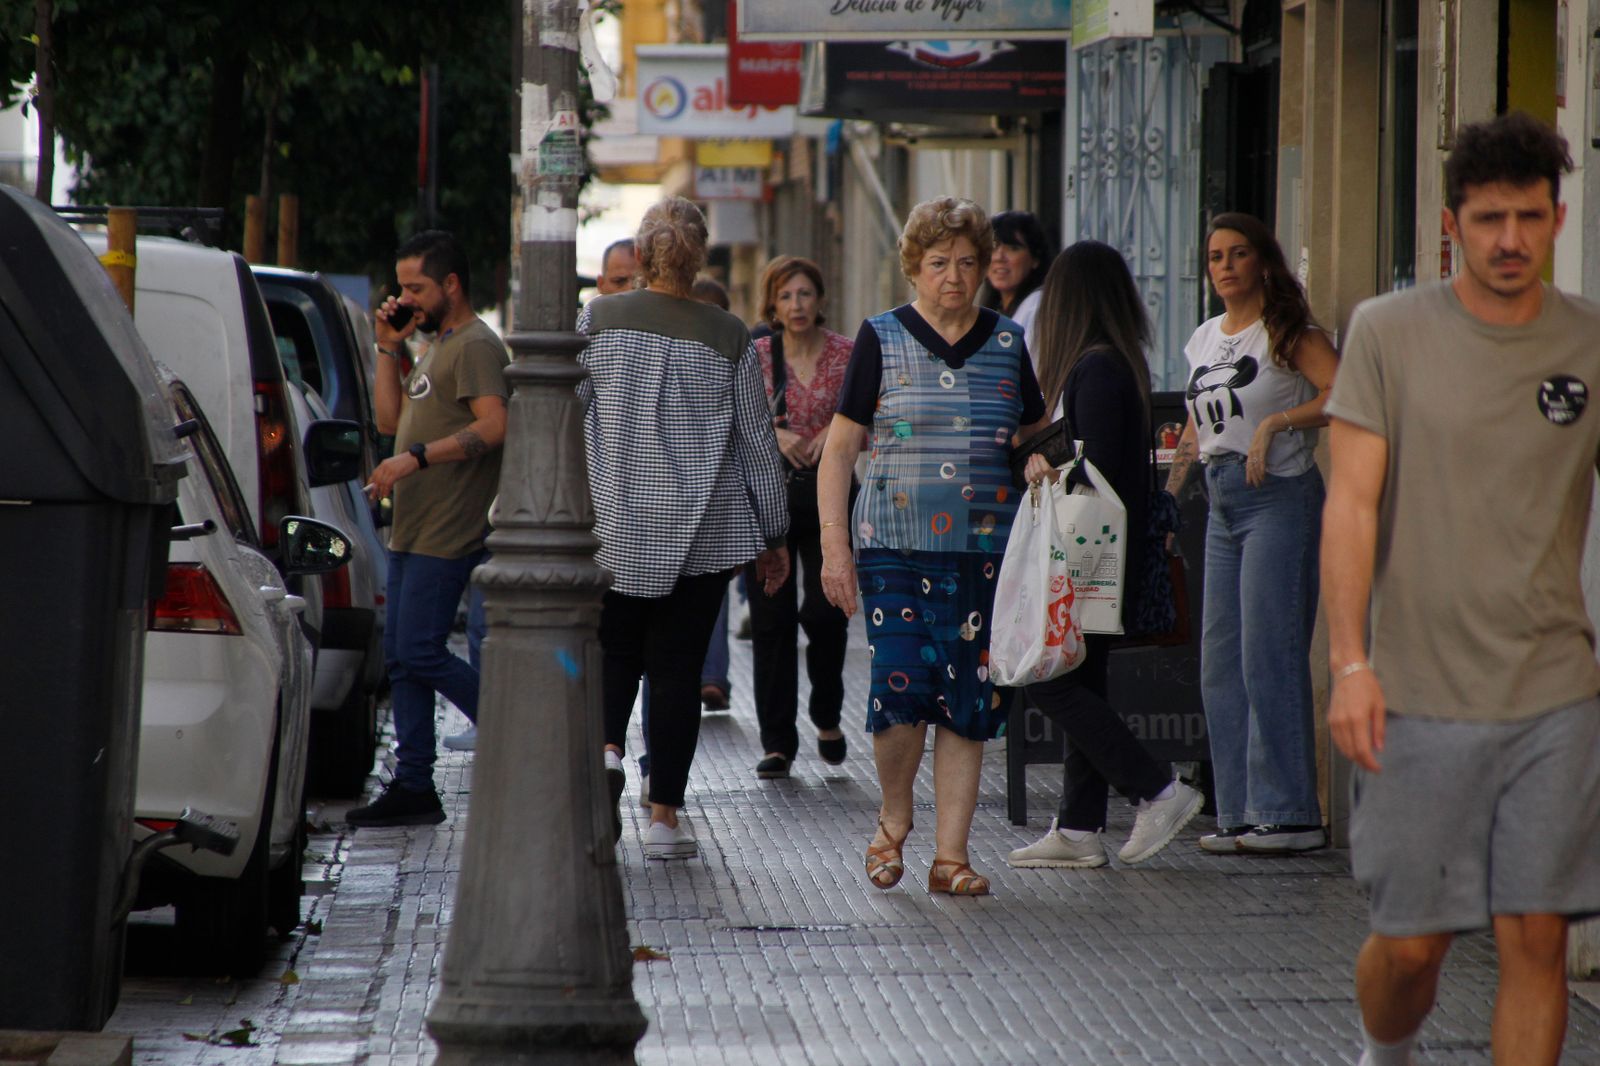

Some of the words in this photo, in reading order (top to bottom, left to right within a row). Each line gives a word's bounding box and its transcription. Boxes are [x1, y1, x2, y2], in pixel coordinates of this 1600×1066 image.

[830, 0, 897, 15] Delicia
[904, 0, 925, 13] de
[931, 0, 984, 22] Mujer
